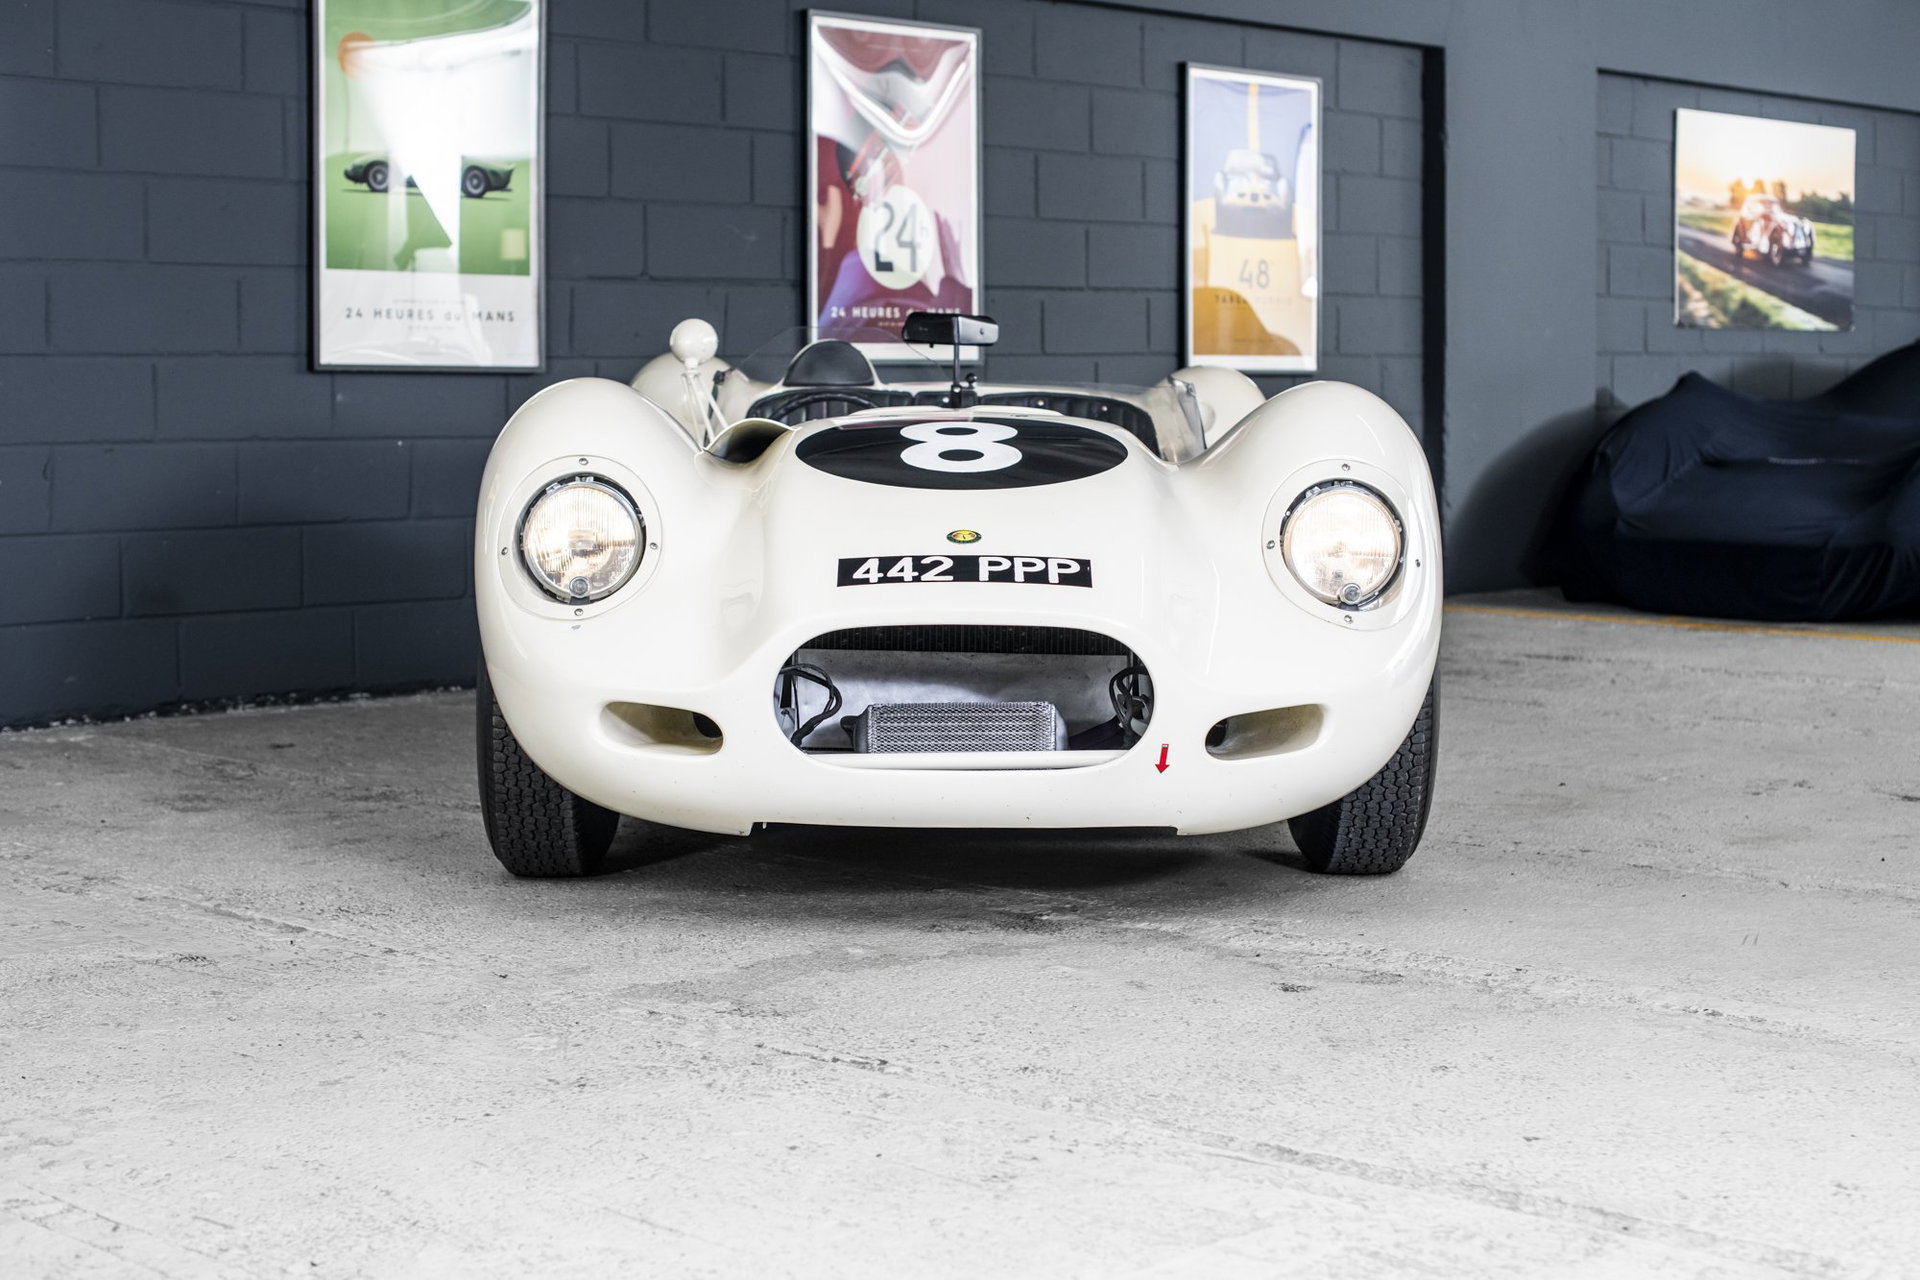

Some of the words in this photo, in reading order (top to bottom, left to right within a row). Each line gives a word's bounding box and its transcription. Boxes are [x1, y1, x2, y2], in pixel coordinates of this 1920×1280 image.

[873, 201, 920, 273] 24
[1238, 259, 1271, 289] 48
[344, 306, 364, 320] 24
[372, 307, 435, 321] HEURES
[472, 309, 516, 323] MANS
[830, 305, 847, 319] 24
[852, 306, 901, 319] HEURES
[900, 421, 1023, 473] 8
[852, 556, 954, 583] 442
[978, 556, 1081, 584] PPP
